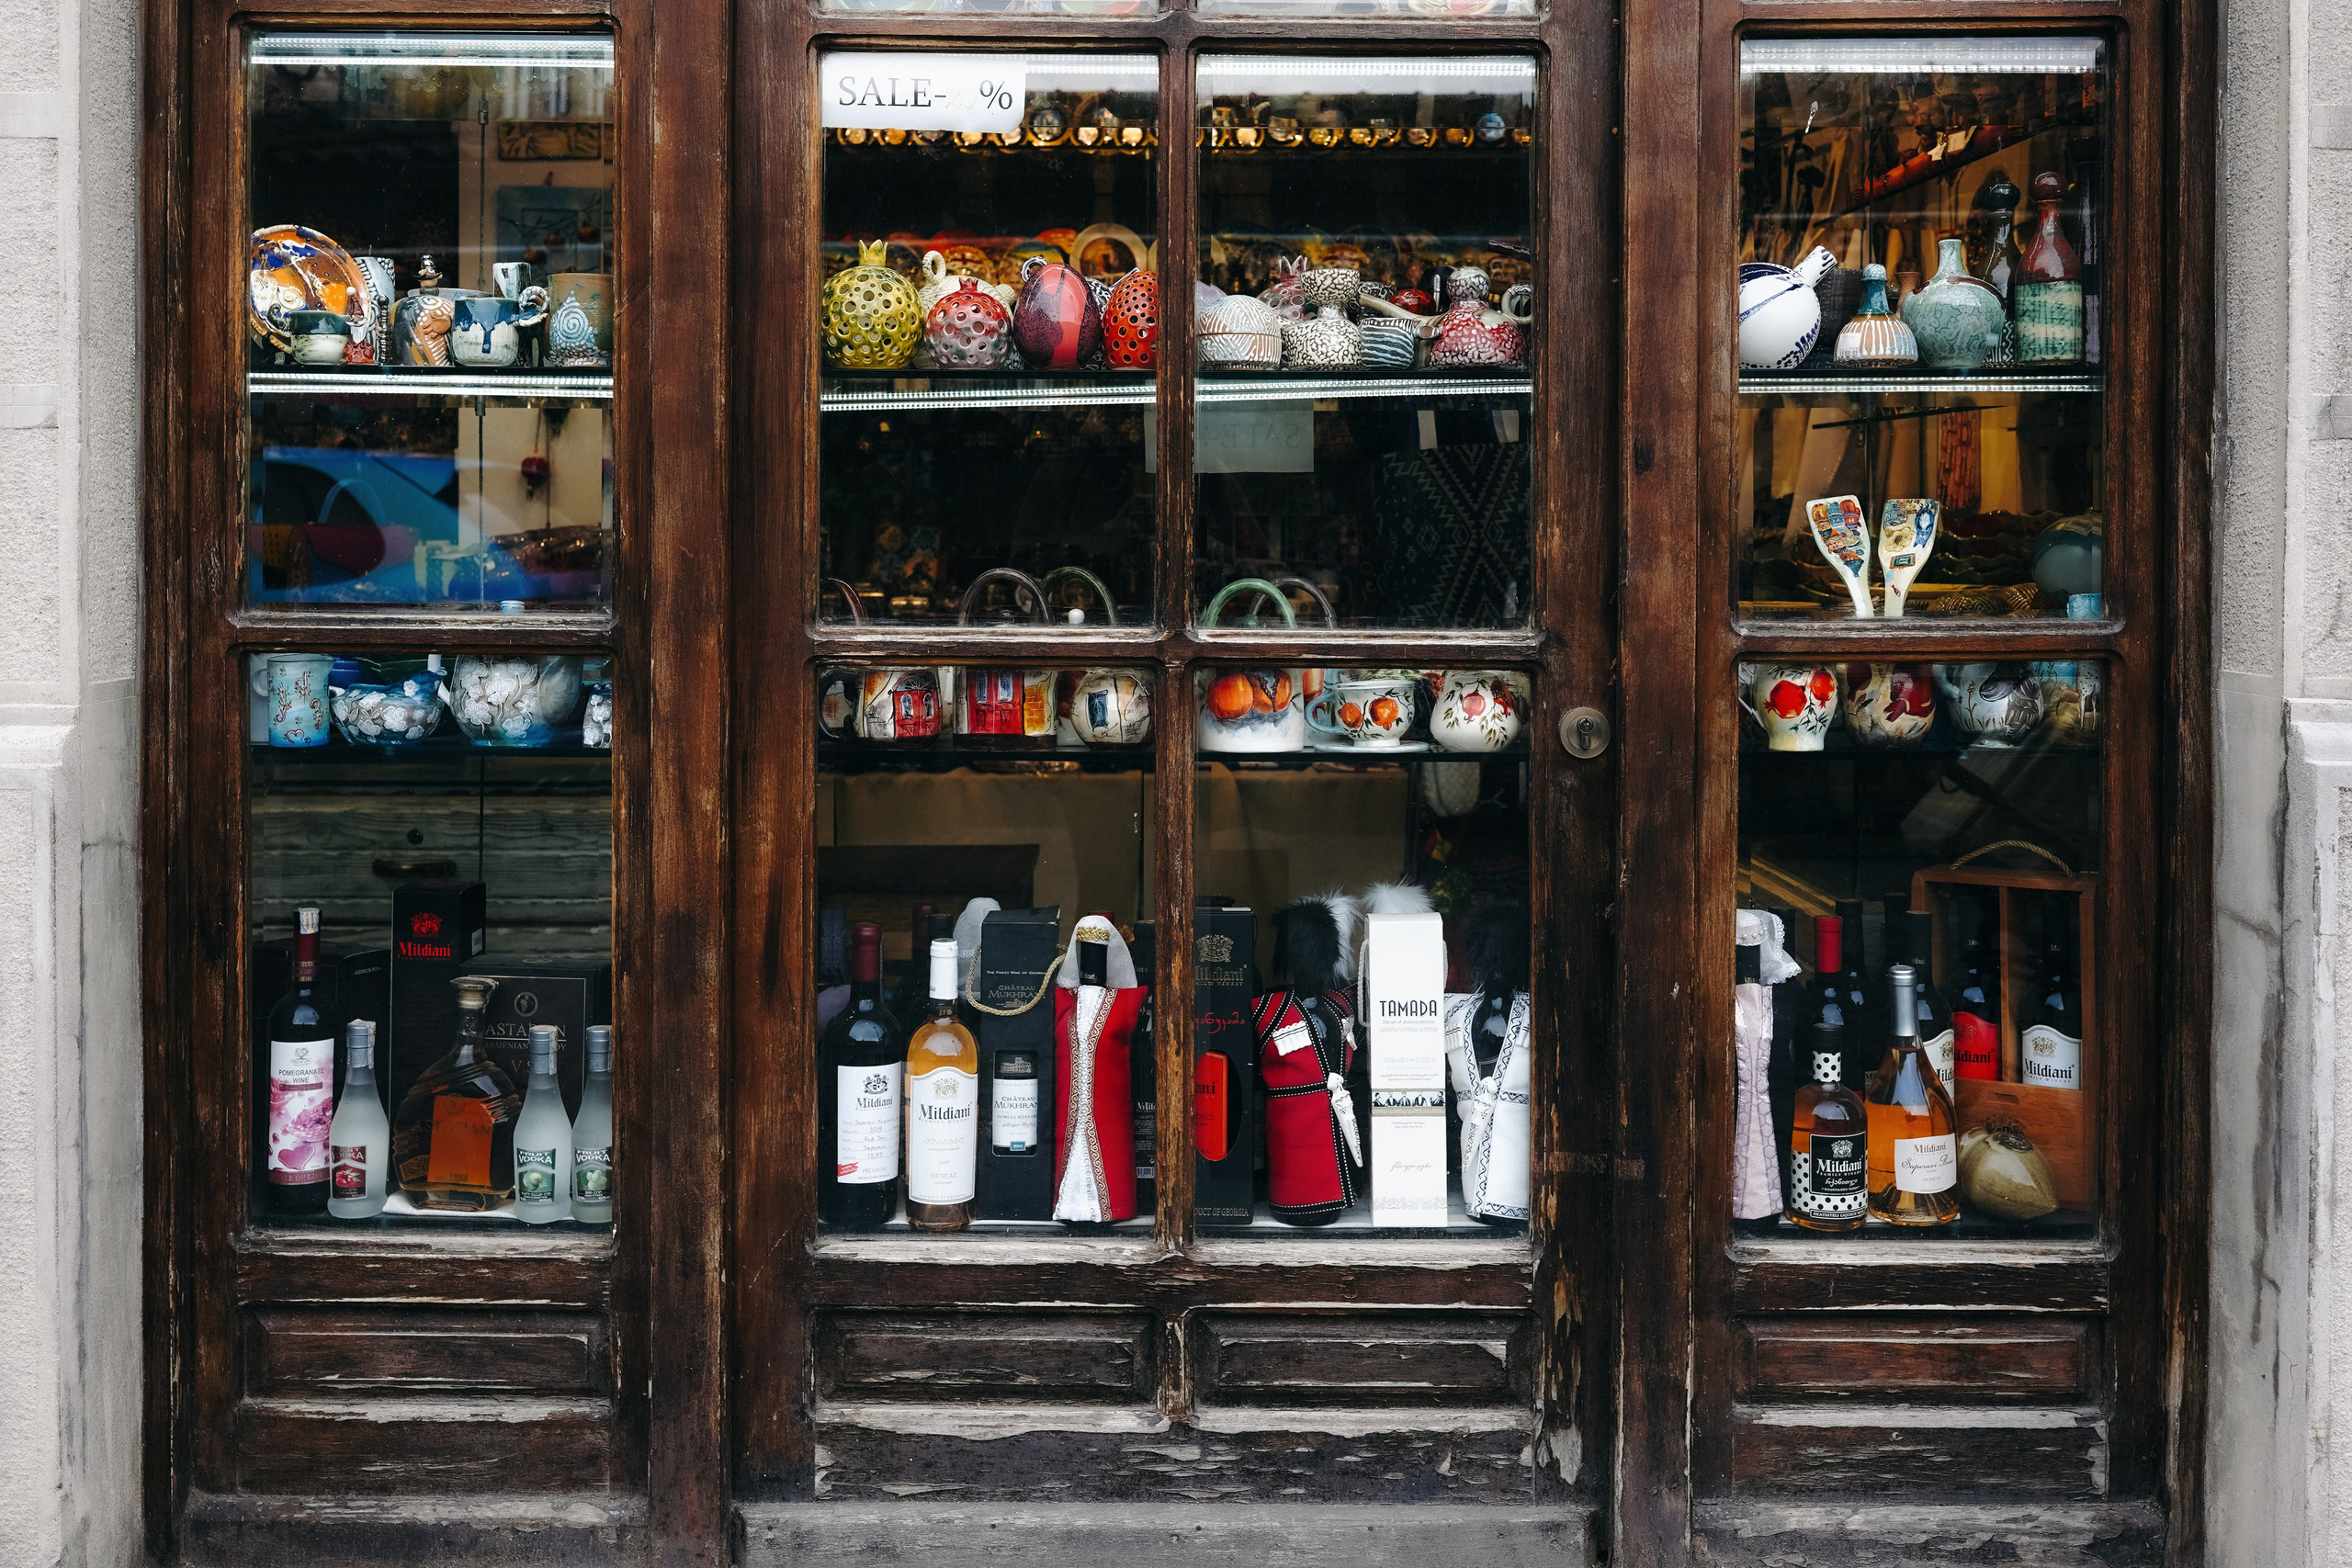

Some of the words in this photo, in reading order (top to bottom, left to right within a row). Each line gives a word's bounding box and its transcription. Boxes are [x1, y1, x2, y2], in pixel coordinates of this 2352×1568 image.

[397, 941, 451, 958] Mildiani
[988, 989, 1046, 998] MUKHRA
[1379, 999, 1437, 1017] TAMADA
[485, 1021, 566, 1037] ASTAN
[278, 1067, 324, 1077] POMEGRANATE
[2024, 1057, 2073, 1079] Mildiani
[855, 1095, 893, 1111] Mildiani
[919, 1102, 971, 1121] Mildiani
[1466, 1122, 1478, 1154] GEORGIA
[1913, 1142, 1947, 1156] Mildiani
[518, 1154, 553, 1165] VODKA
[576, 1153, 611, 1163] VODKA
[1816, 1157, 1862, 1174] Mildiani
[1212, 1207, 1221, 1216] OF
[1221, 1207, 1250, 1217] GEORGIA
